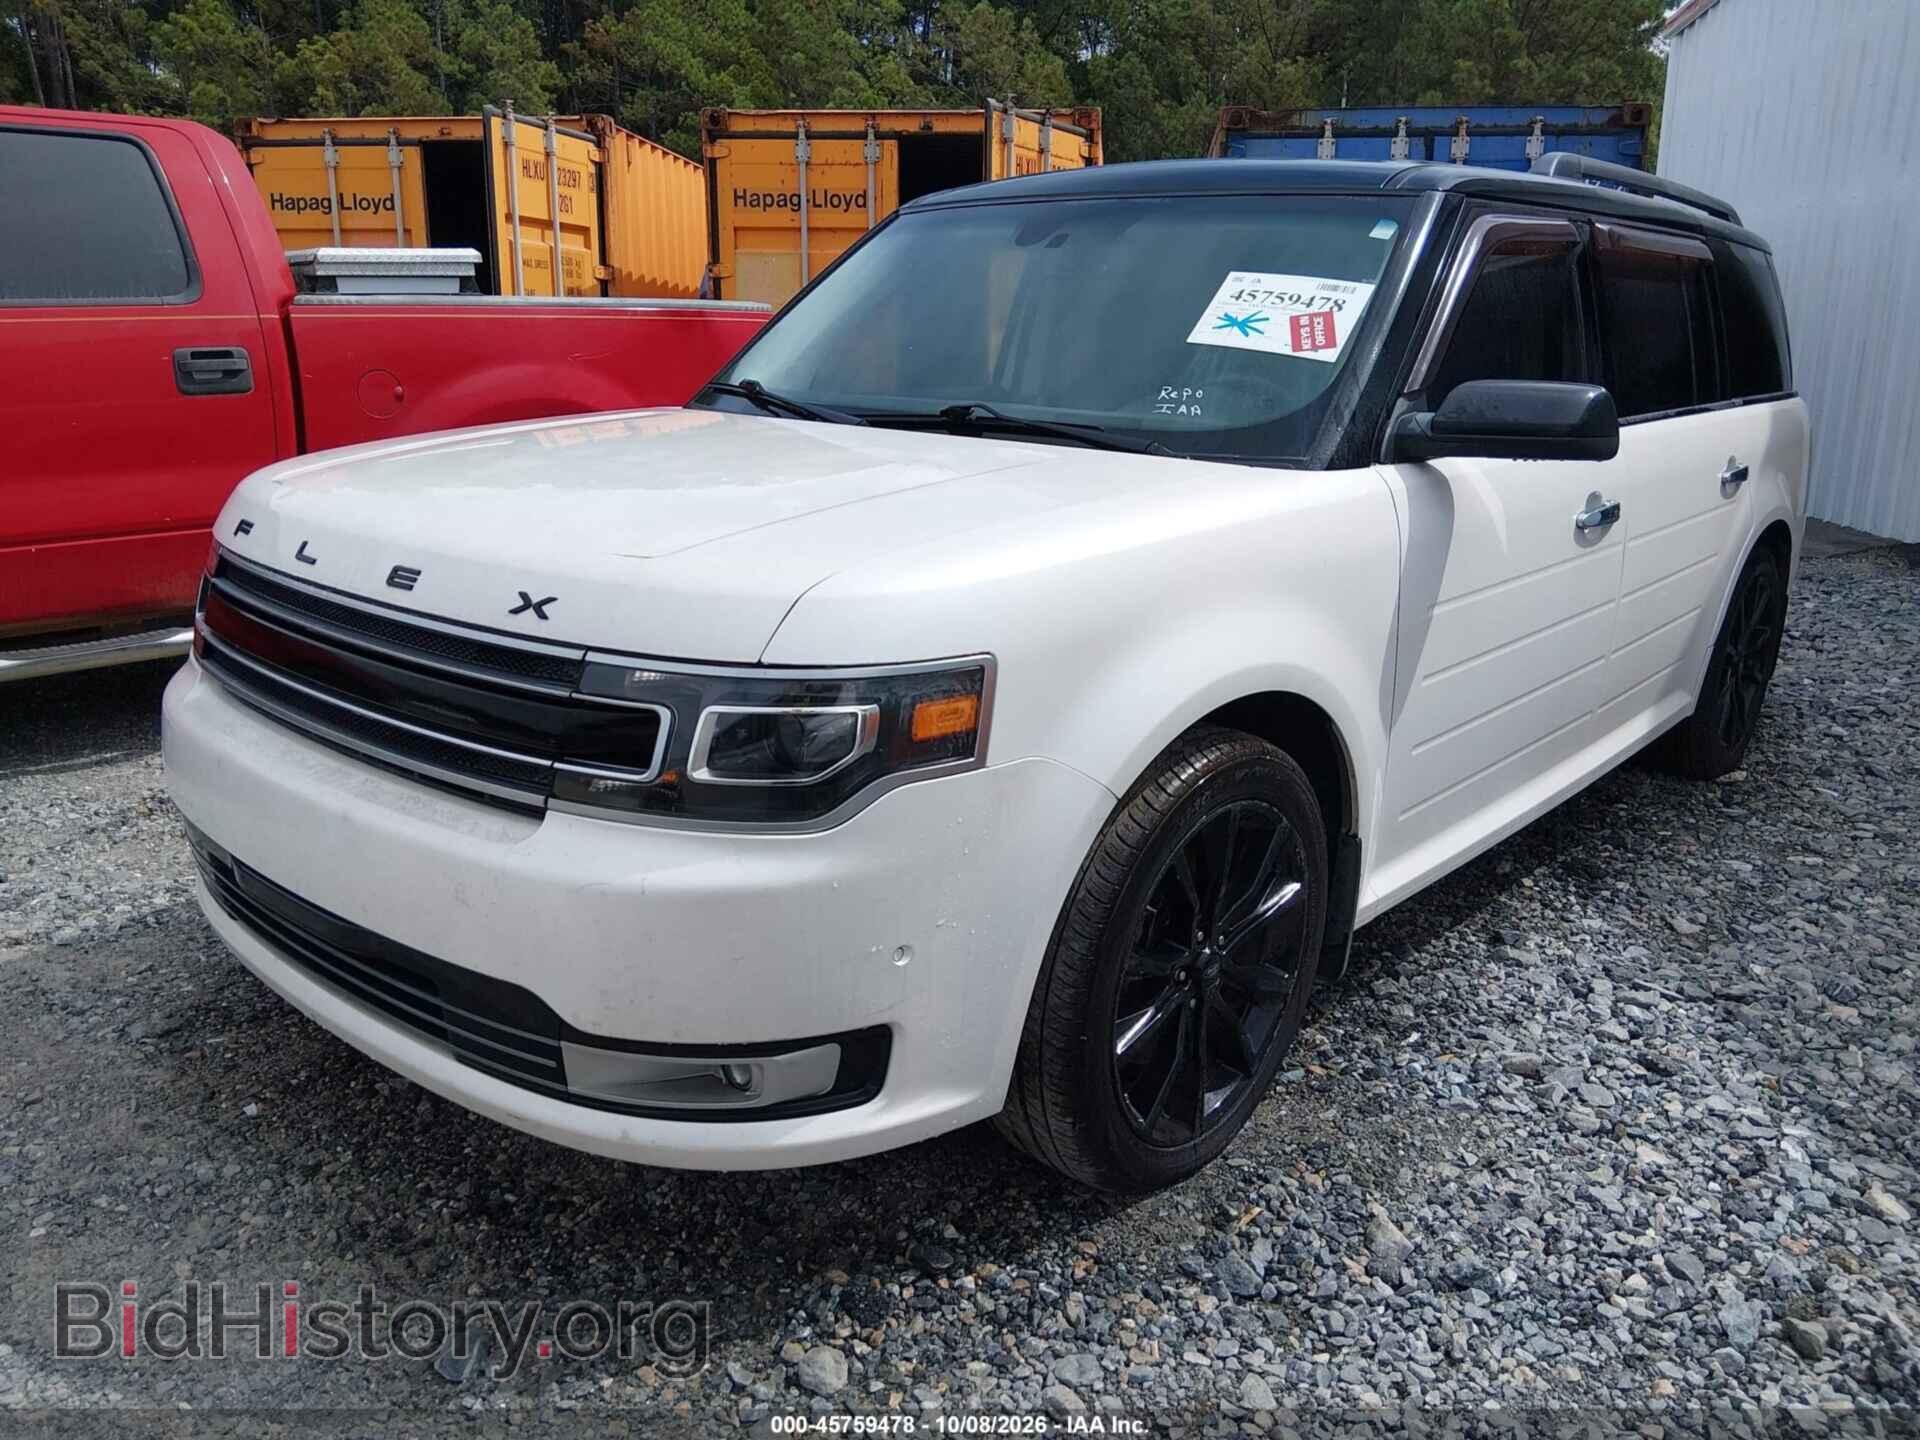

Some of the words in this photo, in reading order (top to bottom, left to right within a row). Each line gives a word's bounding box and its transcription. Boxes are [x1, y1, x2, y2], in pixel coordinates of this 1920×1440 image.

[270, 192, 394, 215] HapagLloyd
[1230, 289, 1346, 313] 45759478
[1299, 315, 1310, 326] IN
[1313, 316, 1326, 346] OFFICE
[1300, 326, 1312, 350] KEYS
